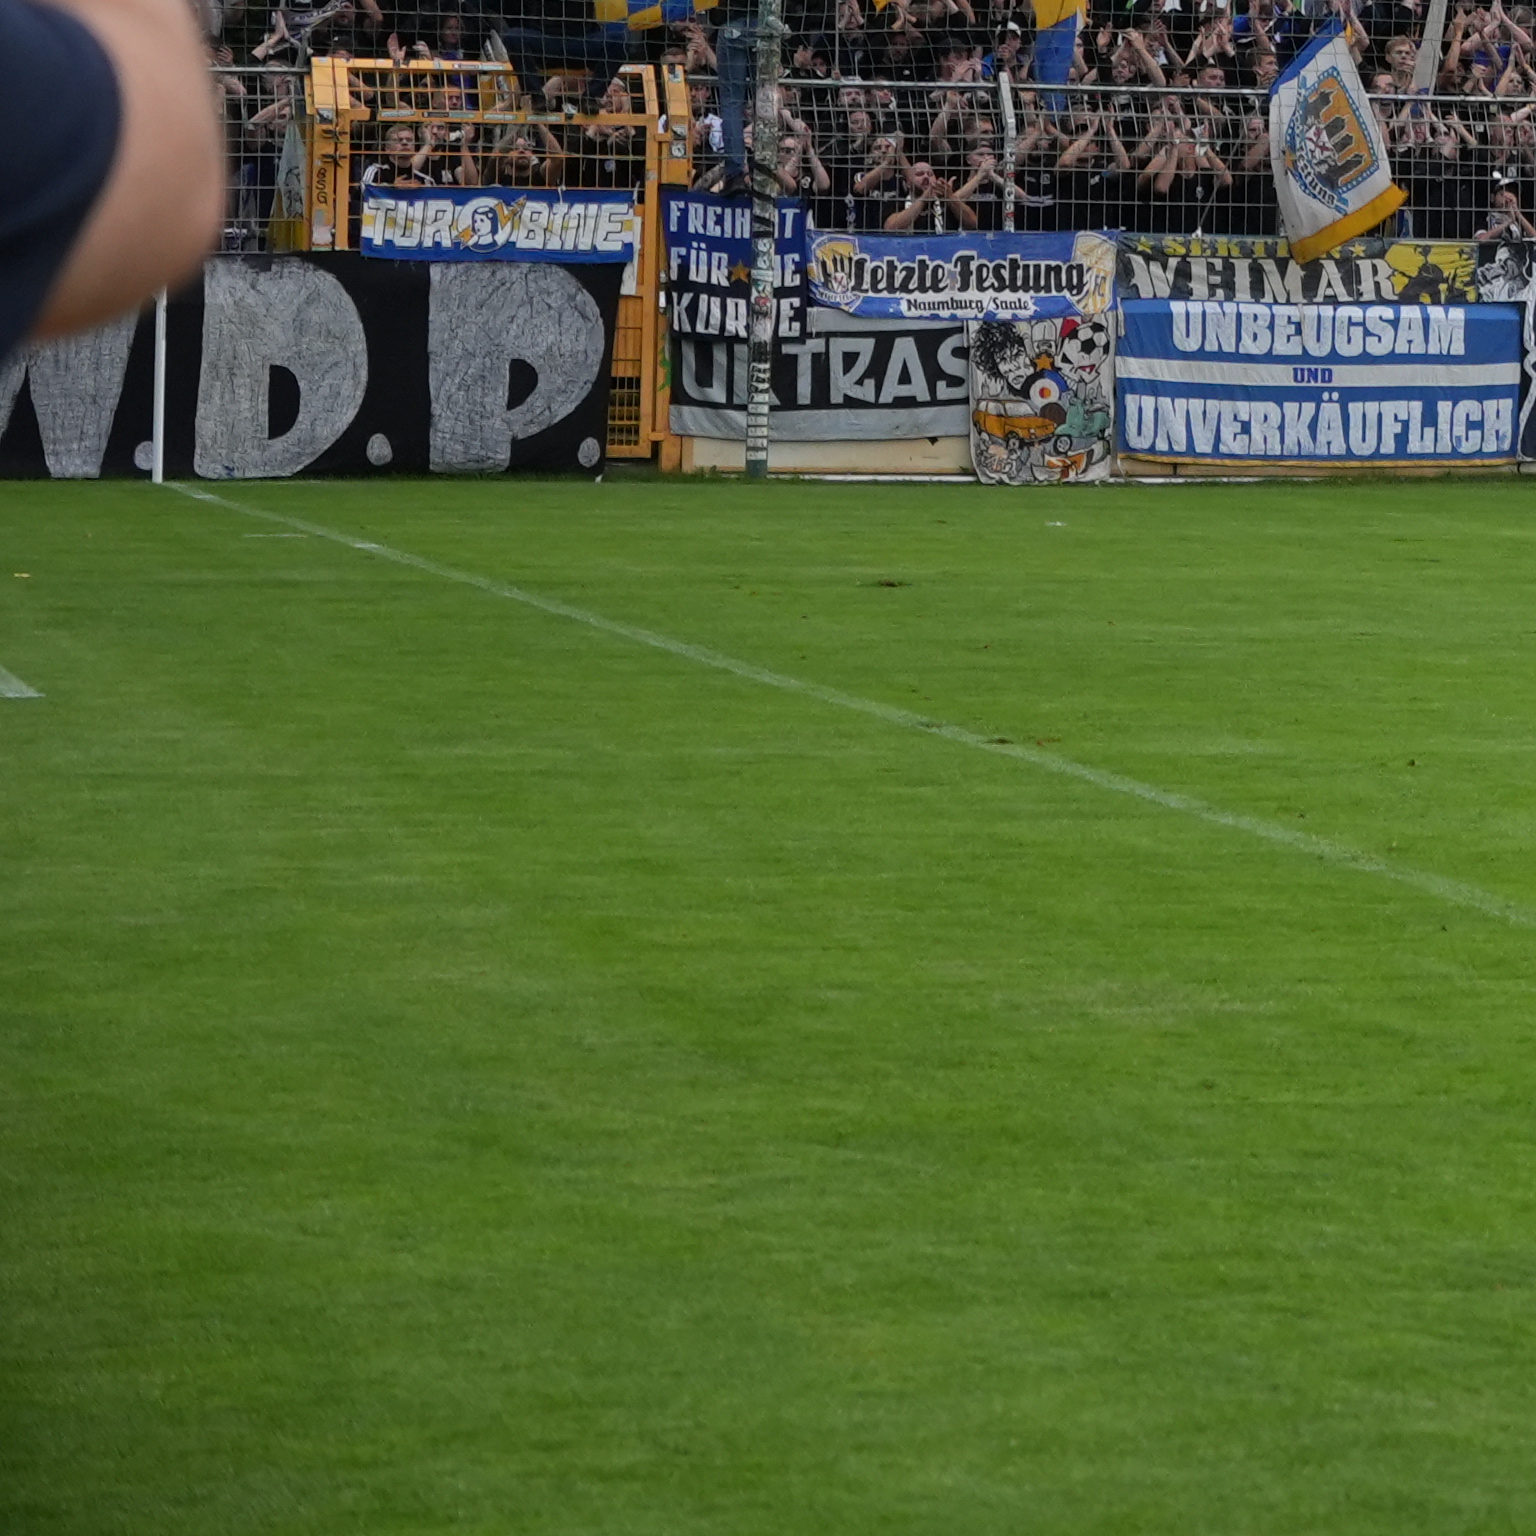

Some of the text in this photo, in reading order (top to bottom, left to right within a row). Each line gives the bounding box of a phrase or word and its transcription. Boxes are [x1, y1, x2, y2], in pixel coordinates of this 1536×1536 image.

[669, 200, 801, 239] FREIHT
[670, 241, 730, 287] FÜR
[850, 252, 1087, 297] Letzte Festung
[1125, 254, 1398, 303] WEIMAR
[672, 291, 801, 338] KURE
[1169, 301, 1465, 355] UNBEUGSAM
[1293, 366, 1334, 385] UND
[1124, 391, 1513, 457] UNVERKÄUFLICH
